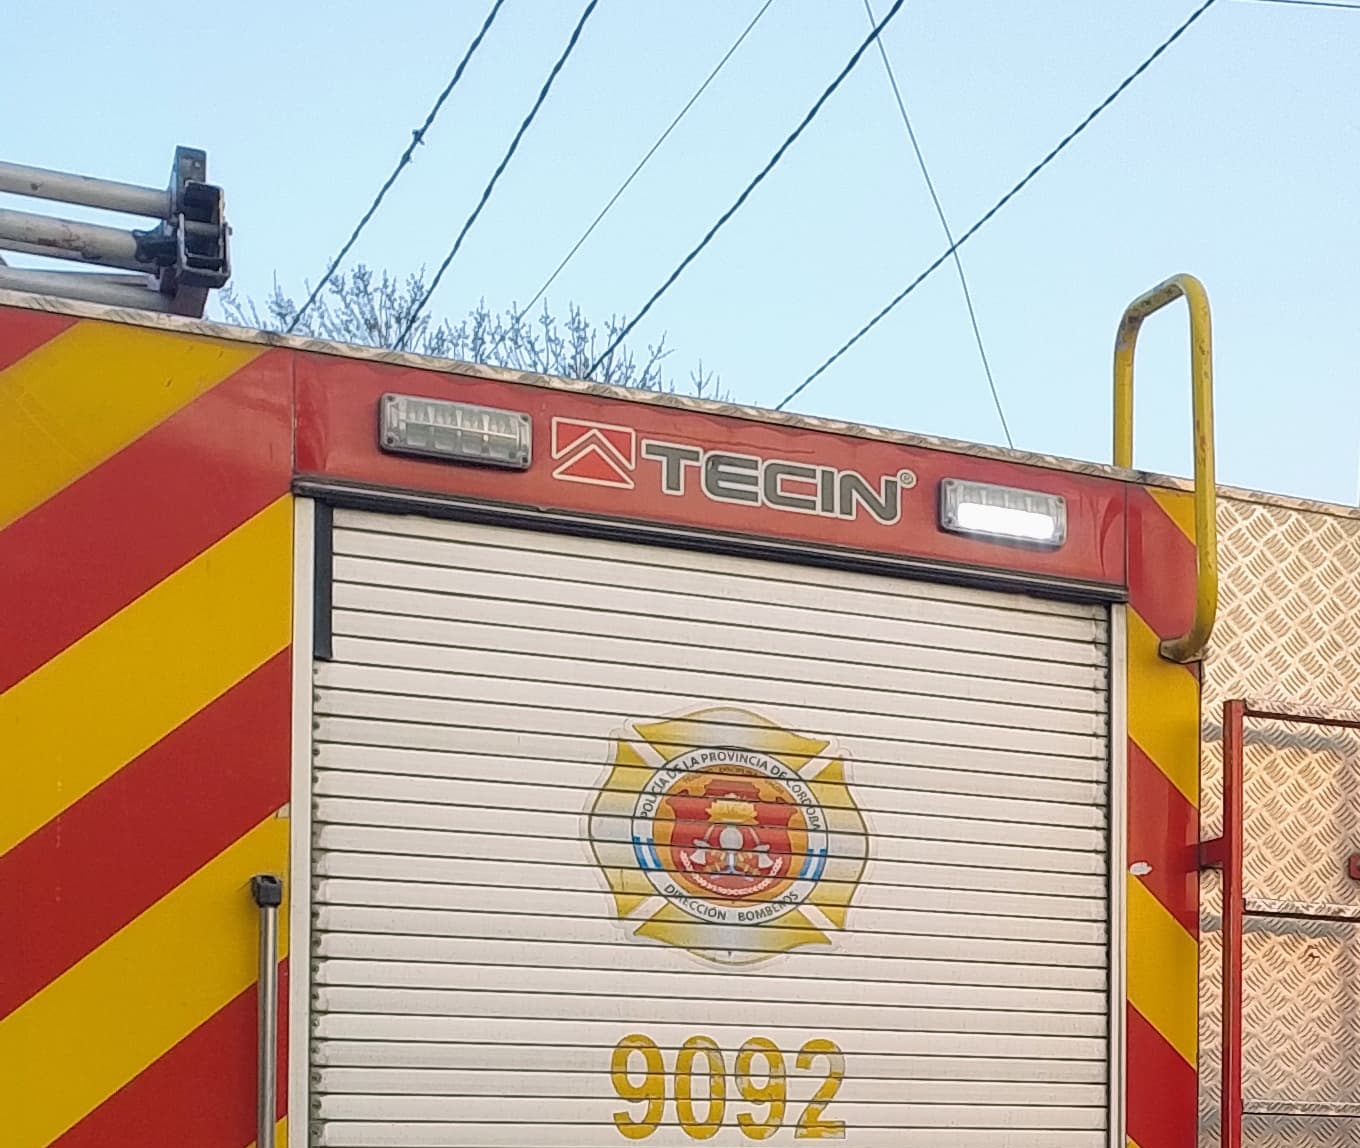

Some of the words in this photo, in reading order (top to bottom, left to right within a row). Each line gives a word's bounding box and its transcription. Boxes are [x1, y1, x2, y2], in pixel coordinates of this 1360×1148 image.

[641, 439, 900, 525] TECIN
[666, 764, 682, 779] DE
[683, 757, 700, 771] LA
[701, 752, 768, 770] PROVINCIA
[770, 765, 788, 779] DE
[738, 891, 799, 921] BOMBEROS
[611, 1034, 846, 1139] 9092
